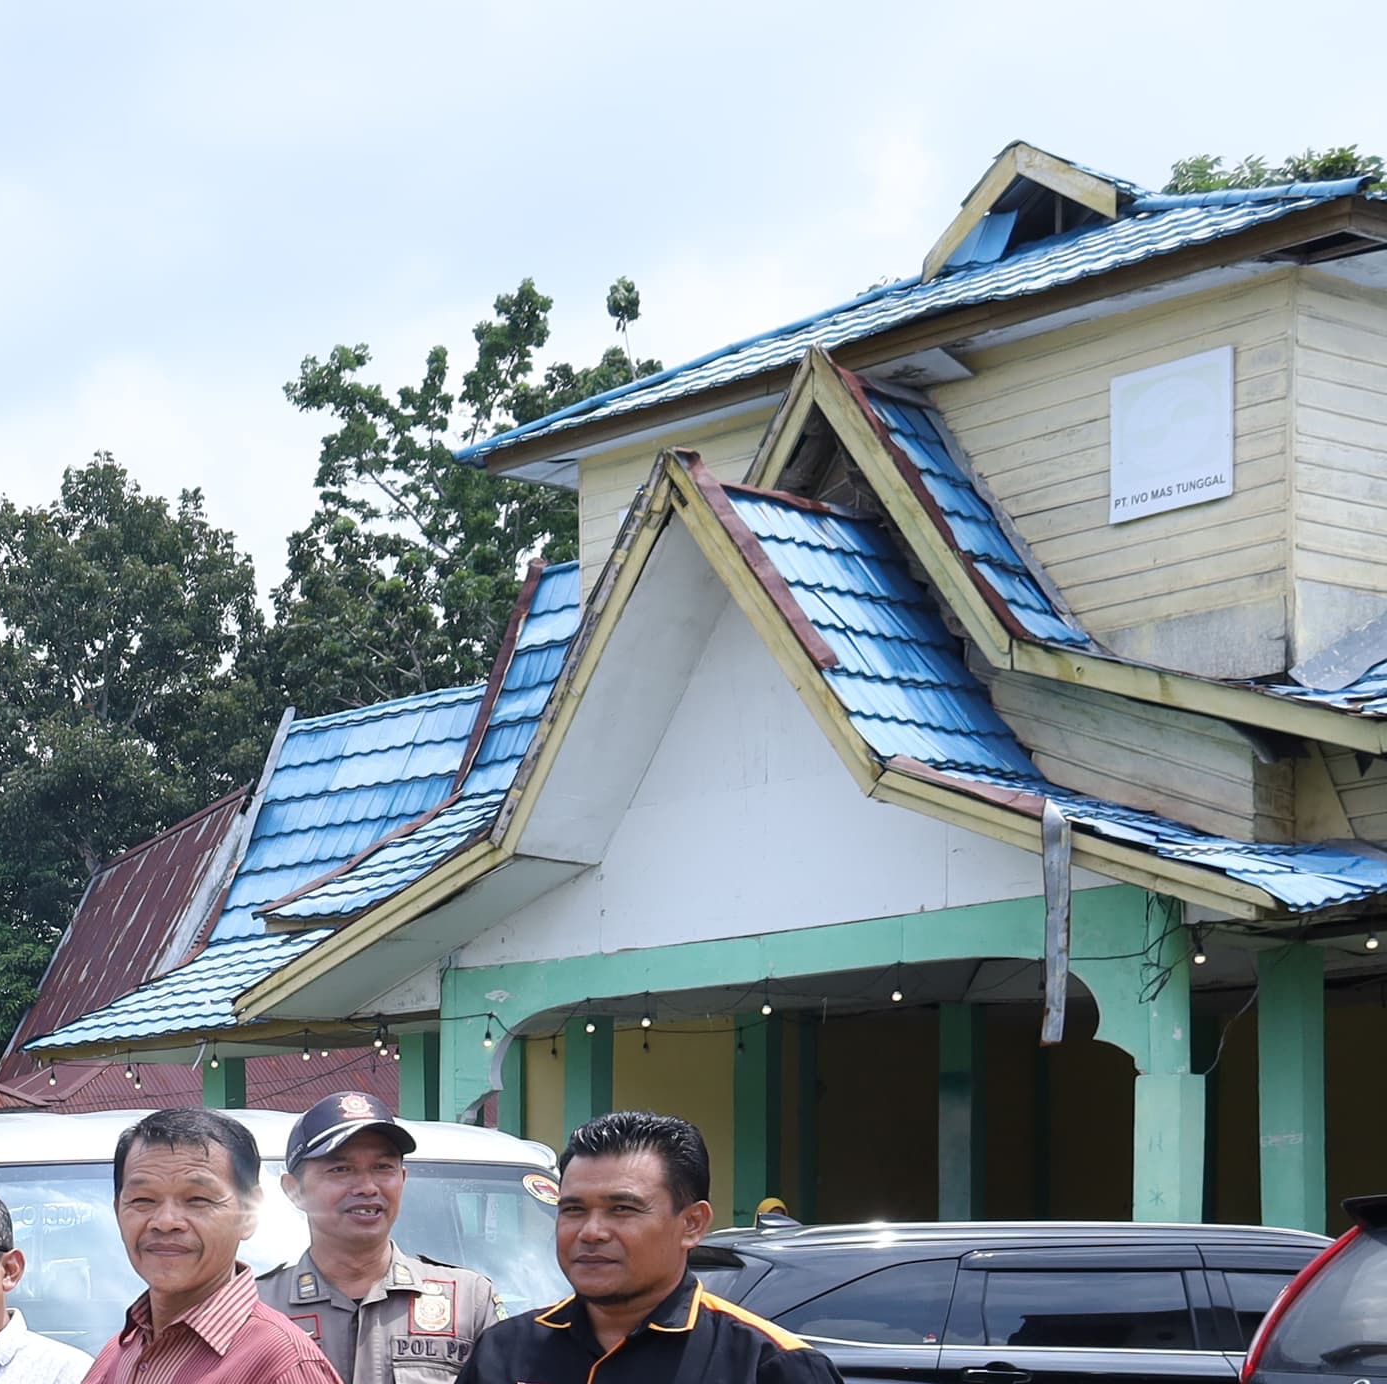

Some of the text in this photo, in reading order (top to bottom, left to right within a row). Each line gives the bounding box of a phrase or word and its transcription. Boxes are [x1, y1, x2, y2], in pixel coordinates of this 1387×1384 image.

[1114, 473, 1226, 509] PT. IVO MAS TUNGGAL
[396, 1339, 470, 1361] POL PP
